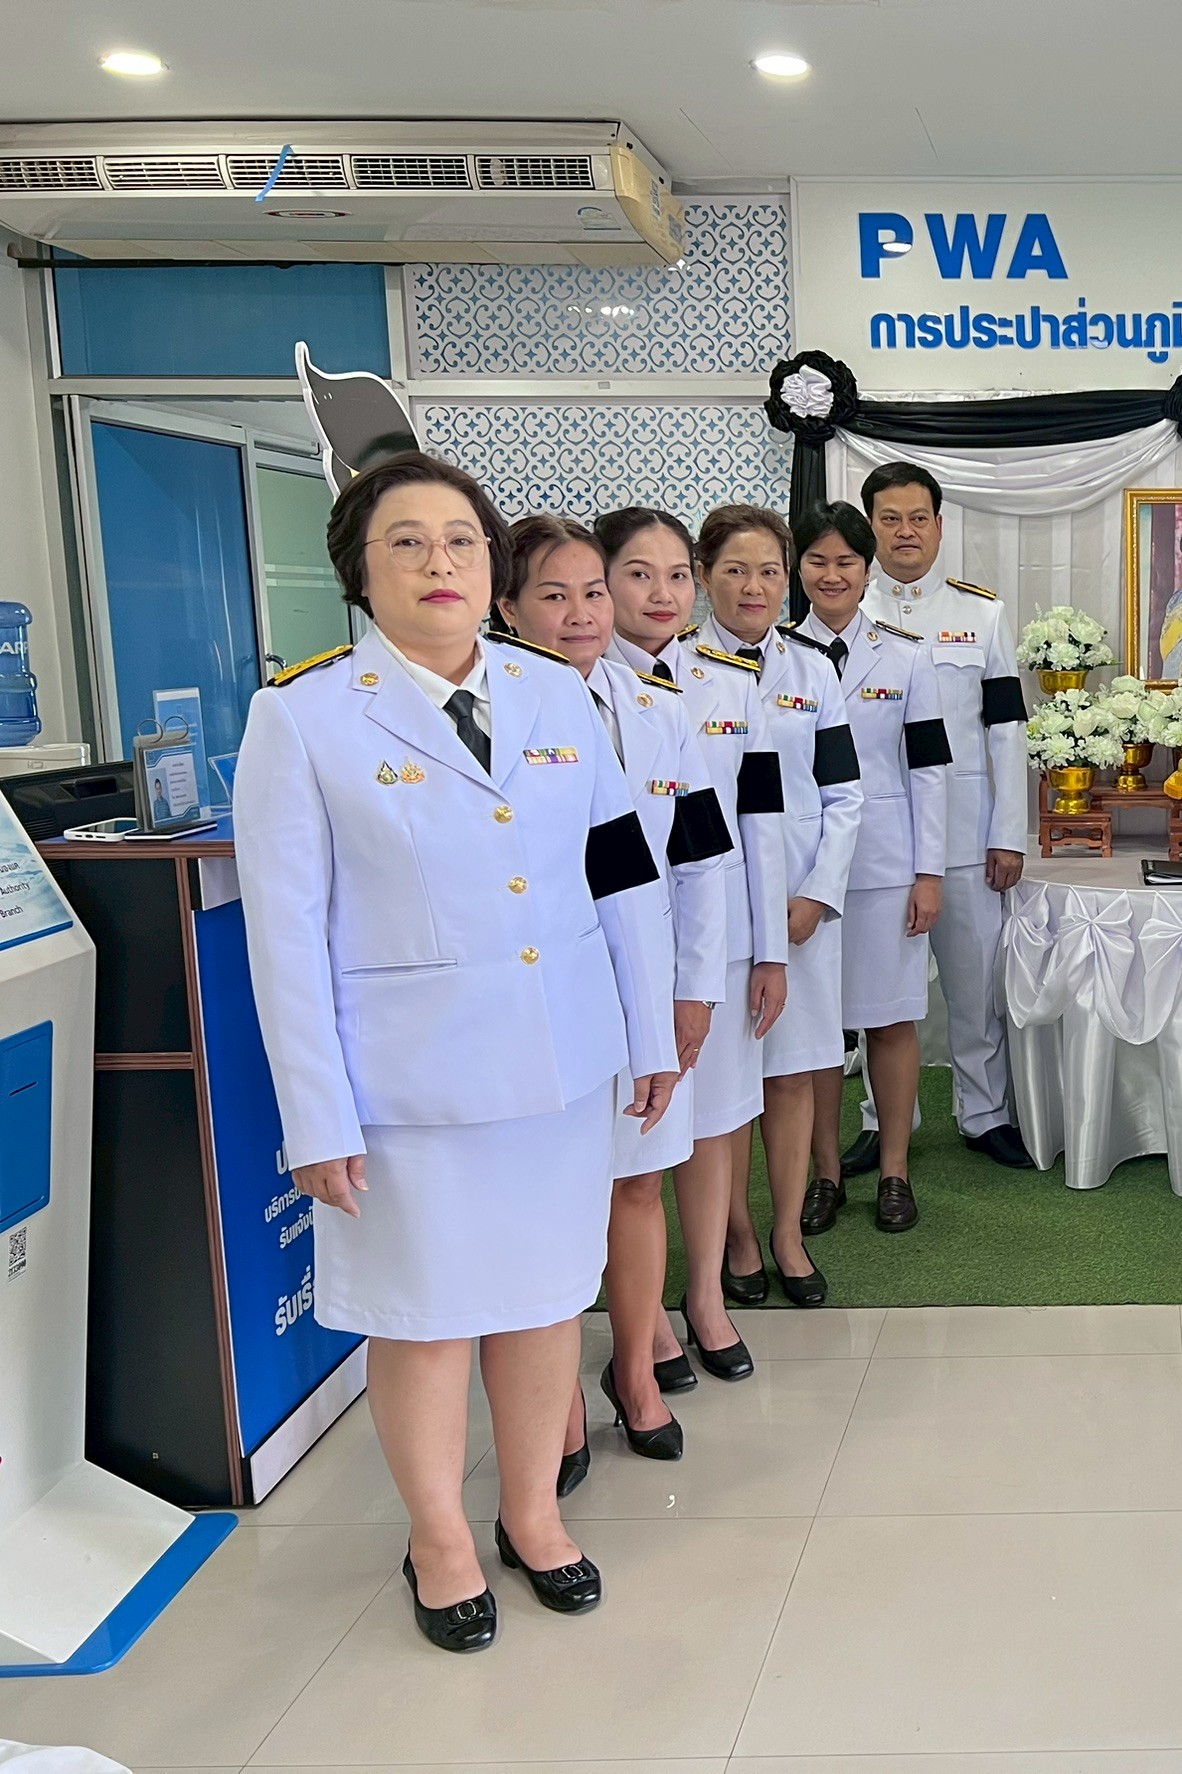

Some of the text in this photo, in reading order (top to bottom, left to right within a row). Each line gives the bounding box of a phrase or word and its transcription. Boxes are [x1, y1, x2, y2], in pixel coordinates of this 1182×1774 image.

[858, 212, 1068, 279] PWA
[275, 1265, 314, 1336] รับเรื่
